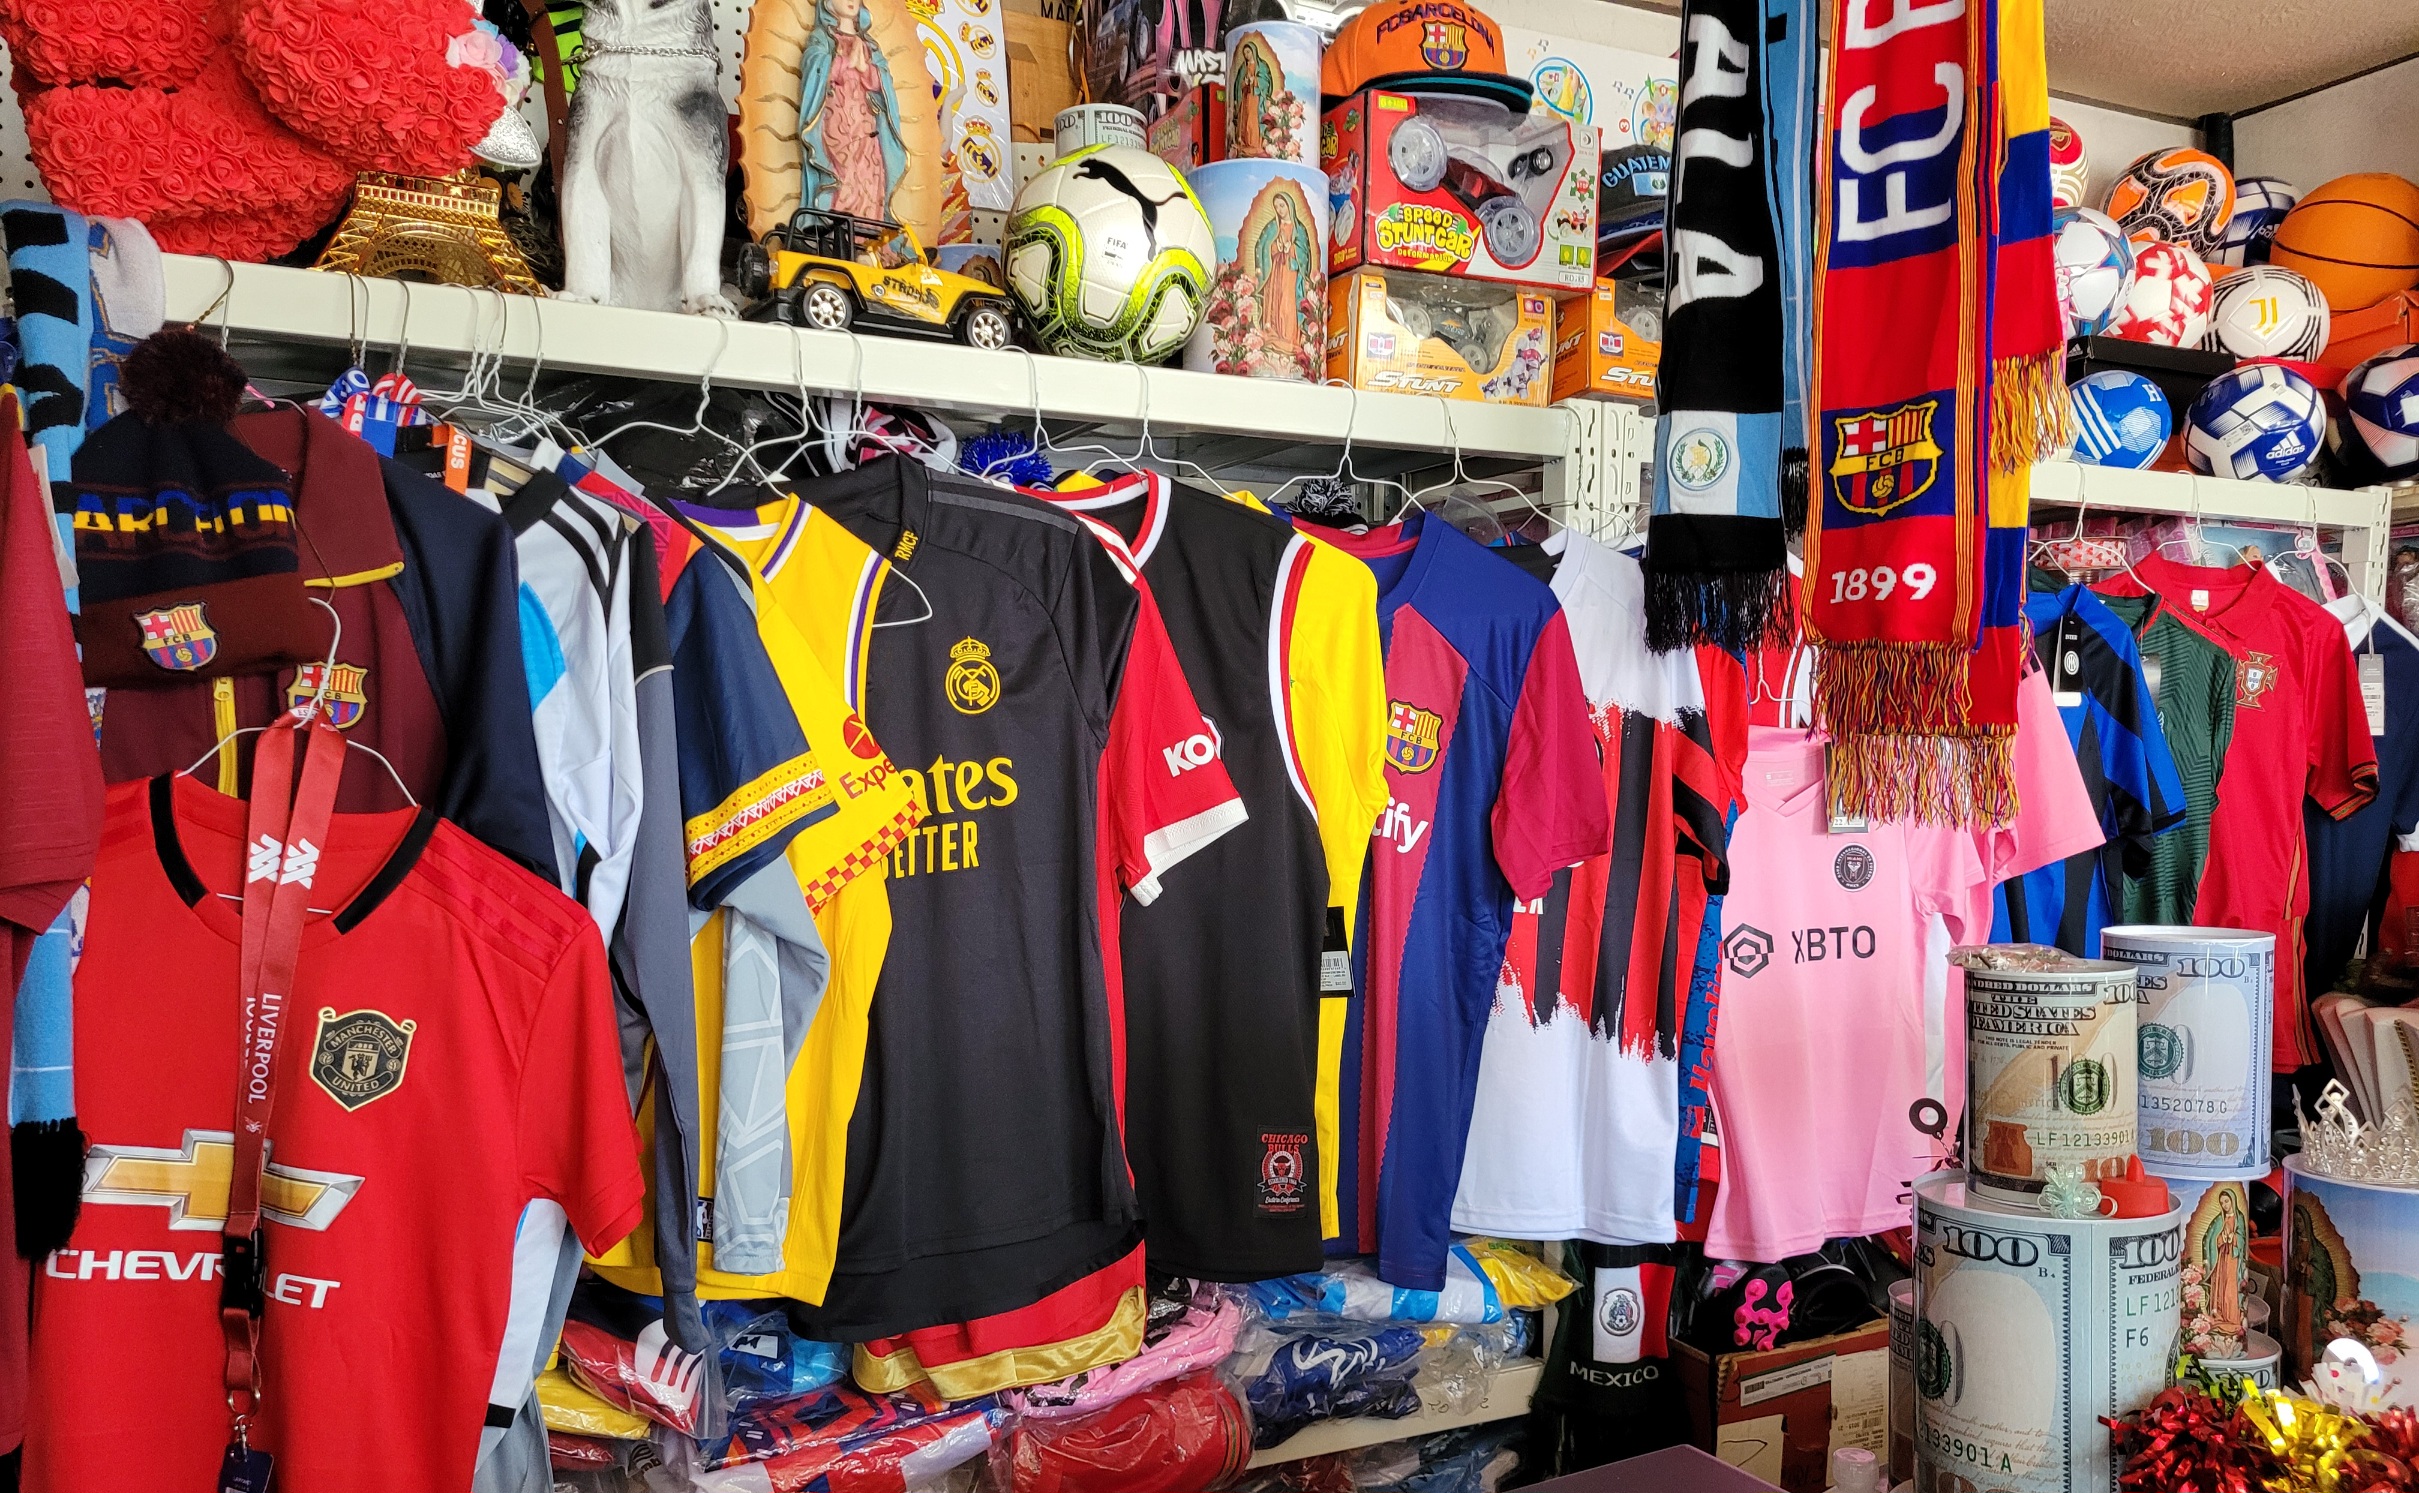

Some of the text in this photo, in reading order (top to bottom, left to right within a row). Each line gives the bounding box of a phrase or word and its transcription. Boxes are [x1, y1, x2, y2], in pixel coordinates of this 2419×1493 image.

[1107, 236, 1127, 249] FIFA
[1866, 448, 1905, 470] FCB
[2266, 444, 2306, 460] adidas
[894, 529, 919, 561] RMCF
[1830, 562, 1937, 604] 1899
[163, 633, 193, 646] FCB
[1400, 731, 1423, 745] FCB
[1791, 925, 1876, 964] XBTO
[2176, 957, 2245, 978] 100
[2015, 983, 2093, 994] DOLLARS
[2012, 1005, 2097, 1020] STATES
[248, 992, 283, 1104] LIVERPOOL
[330, 1025, 397, 1054] MANCHESTER
[331, 1075, 380, 1093] UNITED
[1261, 1133, 1308, 1144] CHICAGO
[1268, 1144, 1299, 1153] BULLS
[2146, 1127, 2240, 1157] 100
[1943, 1225, 2039, 1267] 100
[2119, 1231, 2180, 1270] 100
[46, 1249, 341, 1309] CHEVRLET
[2126, 1296, 2149, 1317] LF
[2126, 1326, 2149, 1348] F6
[1569, 1360, 1659, 1388] MEXICO
[2001, 1453, 2012, 1473] A
